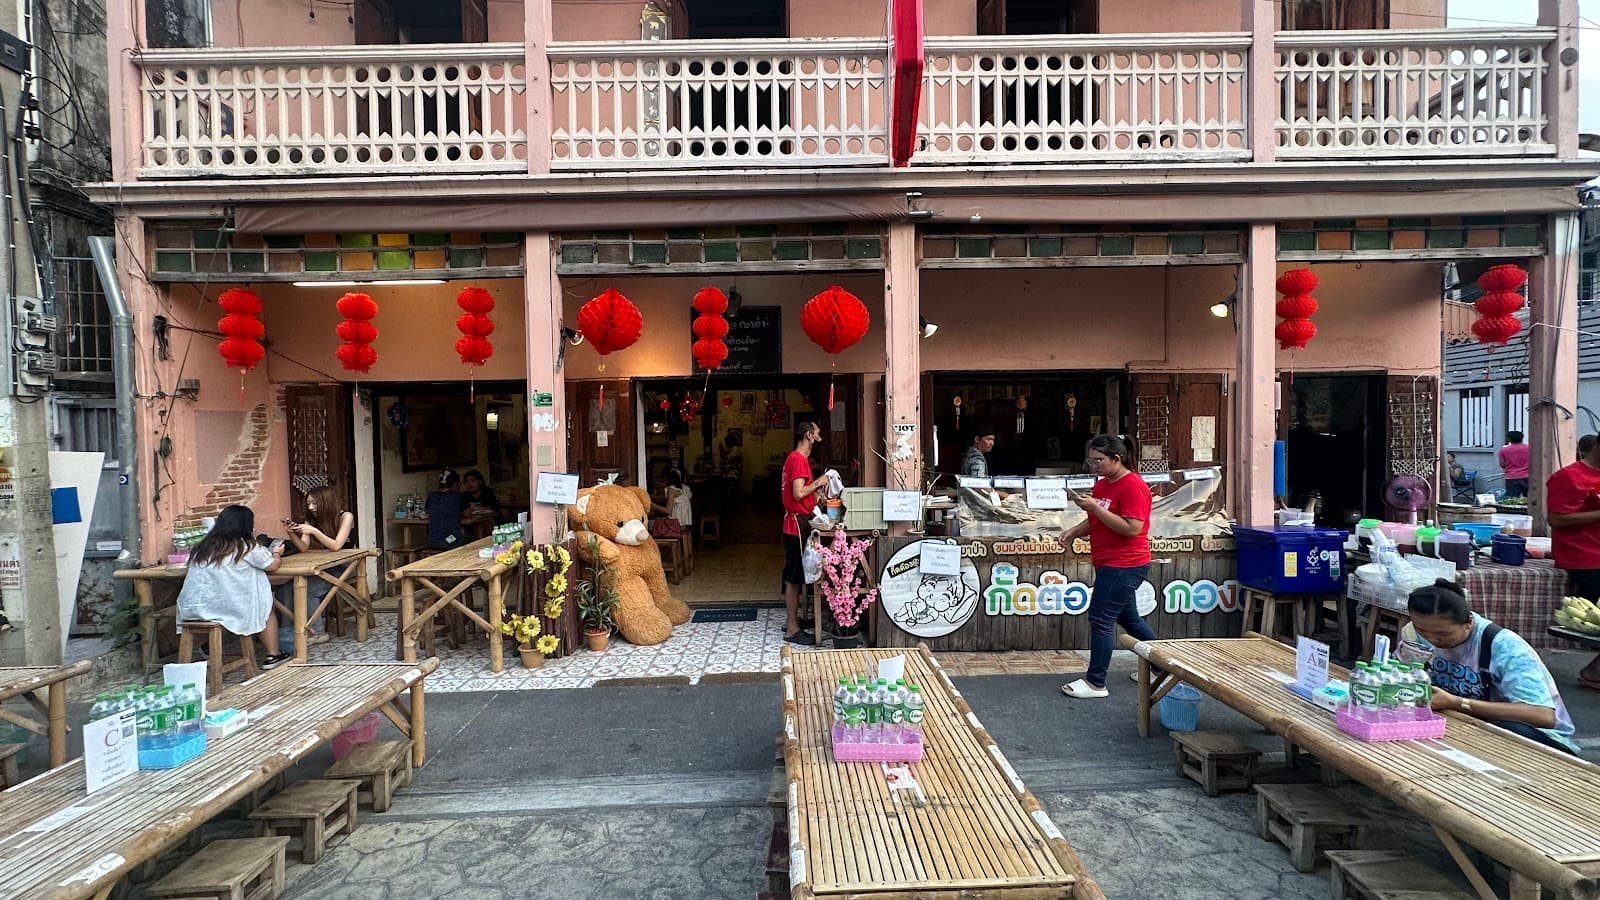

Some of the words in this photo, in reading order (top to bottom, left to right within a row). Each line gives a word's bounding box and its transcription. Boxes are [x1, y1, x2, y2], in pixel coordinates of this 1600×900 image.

[986, 564, 1091, 613] กั๊ดต๊อ
[1166, 582, 1241, 611] กอง
[1306, 652, 1318, 667] A
[104, 728, 120, 747] C
